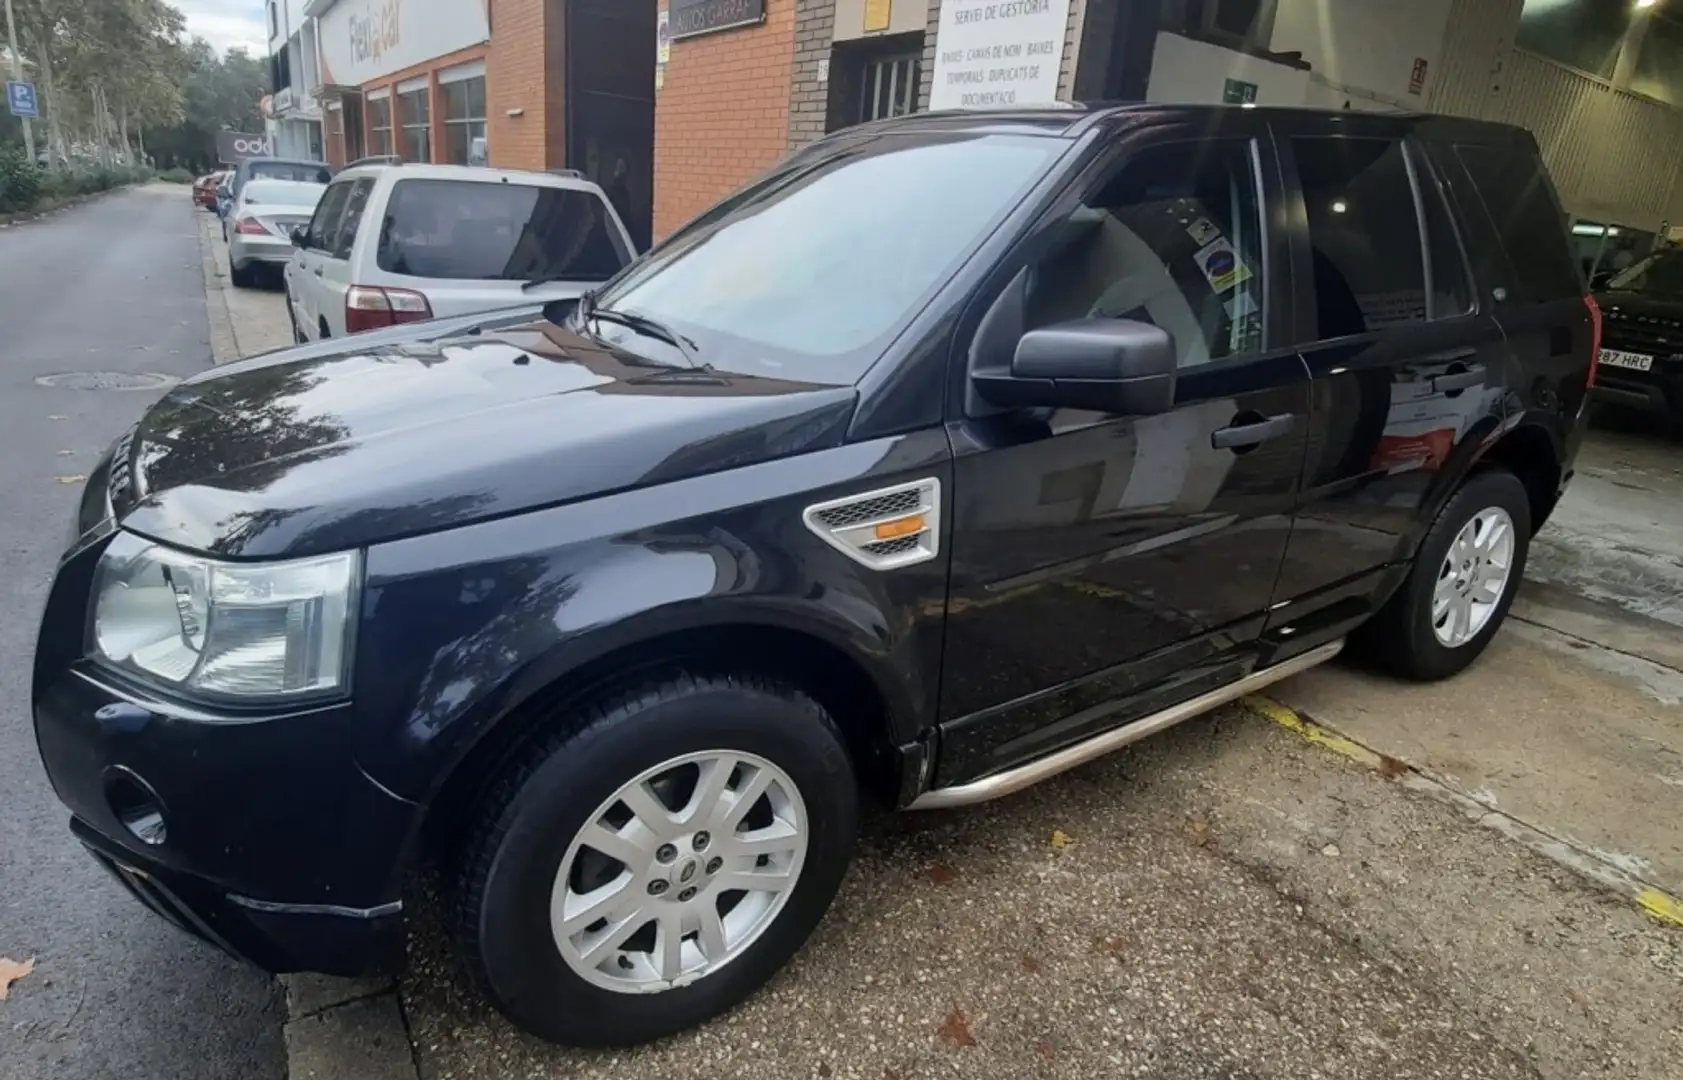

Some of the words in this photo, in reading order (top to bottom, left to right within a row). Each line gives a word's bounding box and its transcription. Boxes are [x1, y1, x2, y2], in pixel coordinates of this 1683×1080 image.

[984, 4, 998, 20] DE
[992, 45, 1003, 59] DE
[1028, 65, 1040, 79] DE
[1621, 354, 1650, 370] HRC
